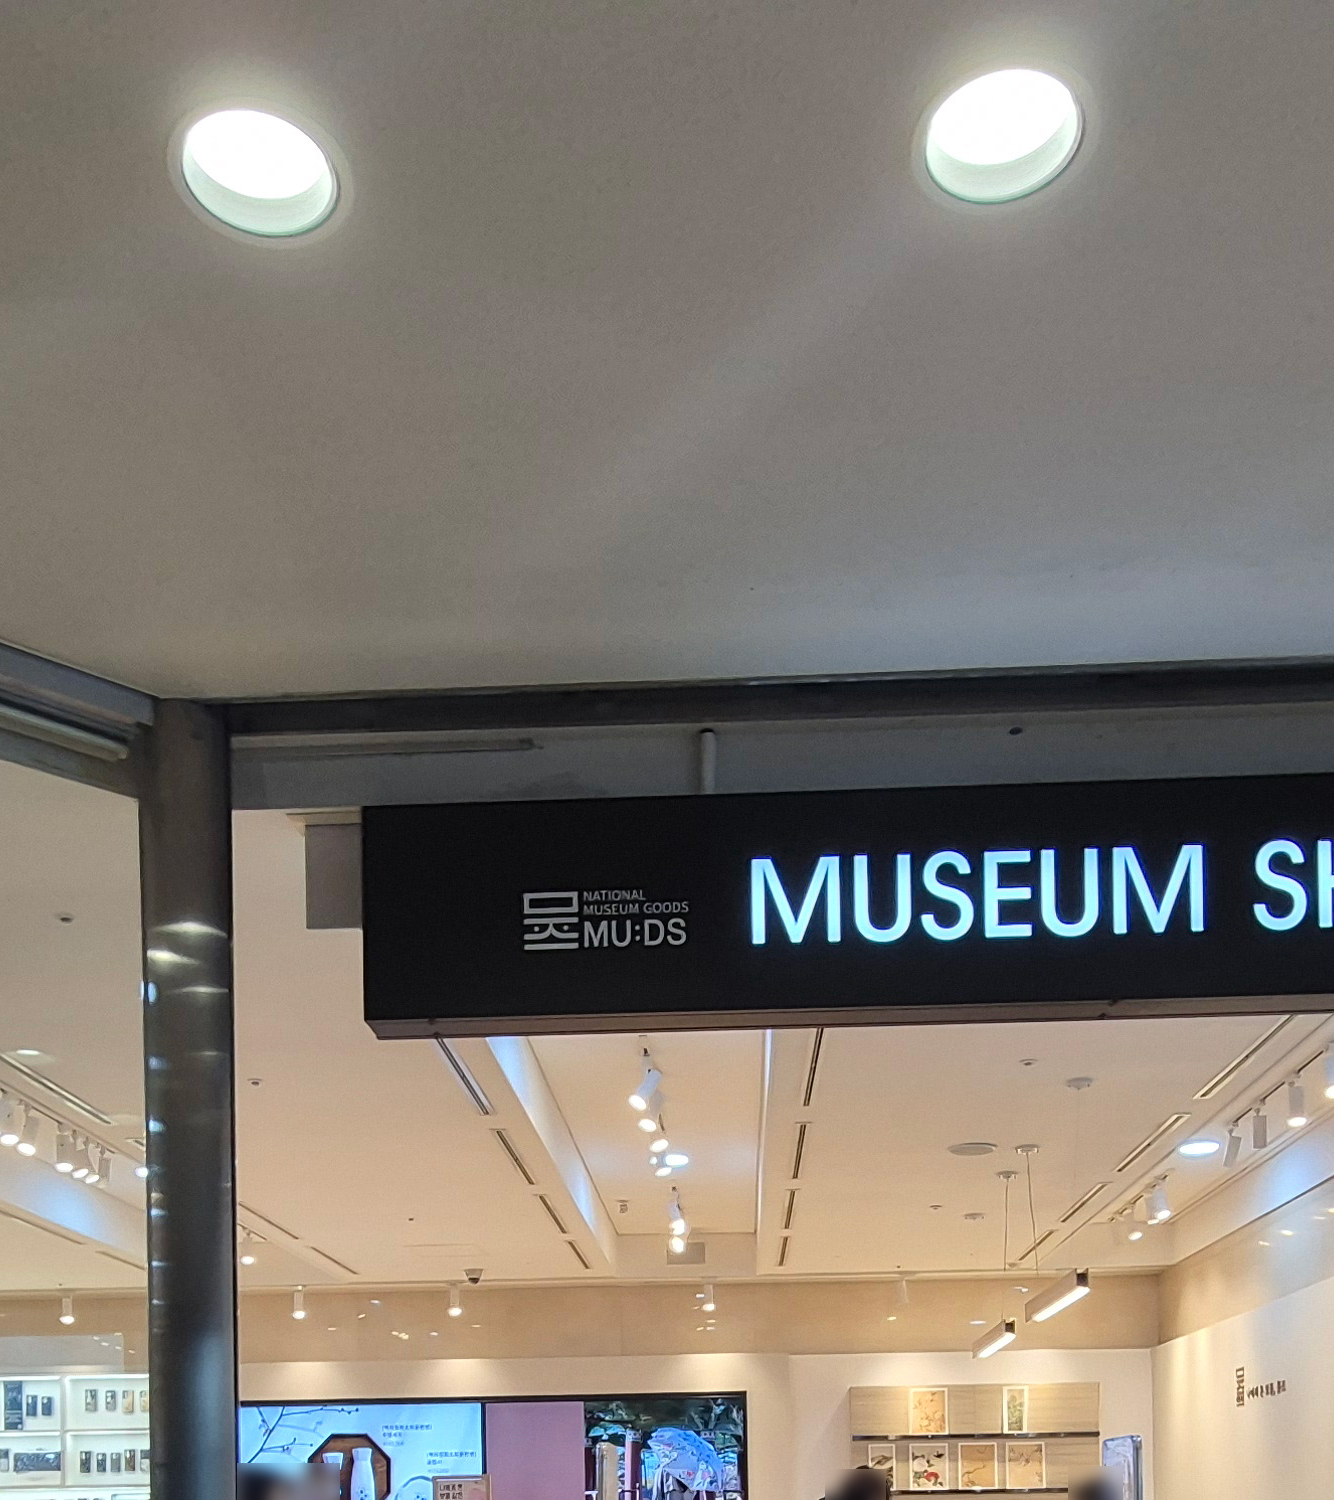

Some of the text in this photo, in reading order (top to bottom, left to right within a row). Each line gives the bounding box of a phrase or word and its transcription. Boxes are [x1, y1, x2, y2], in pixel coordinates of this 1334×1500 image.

[583, 889, 646, 901] NATIONAL
[749, 843, 1206, 946] MUSEUM
[583, 901, 689, 915] MUSEUM GOODS
[583, 917, 687, 948] MU:DS
